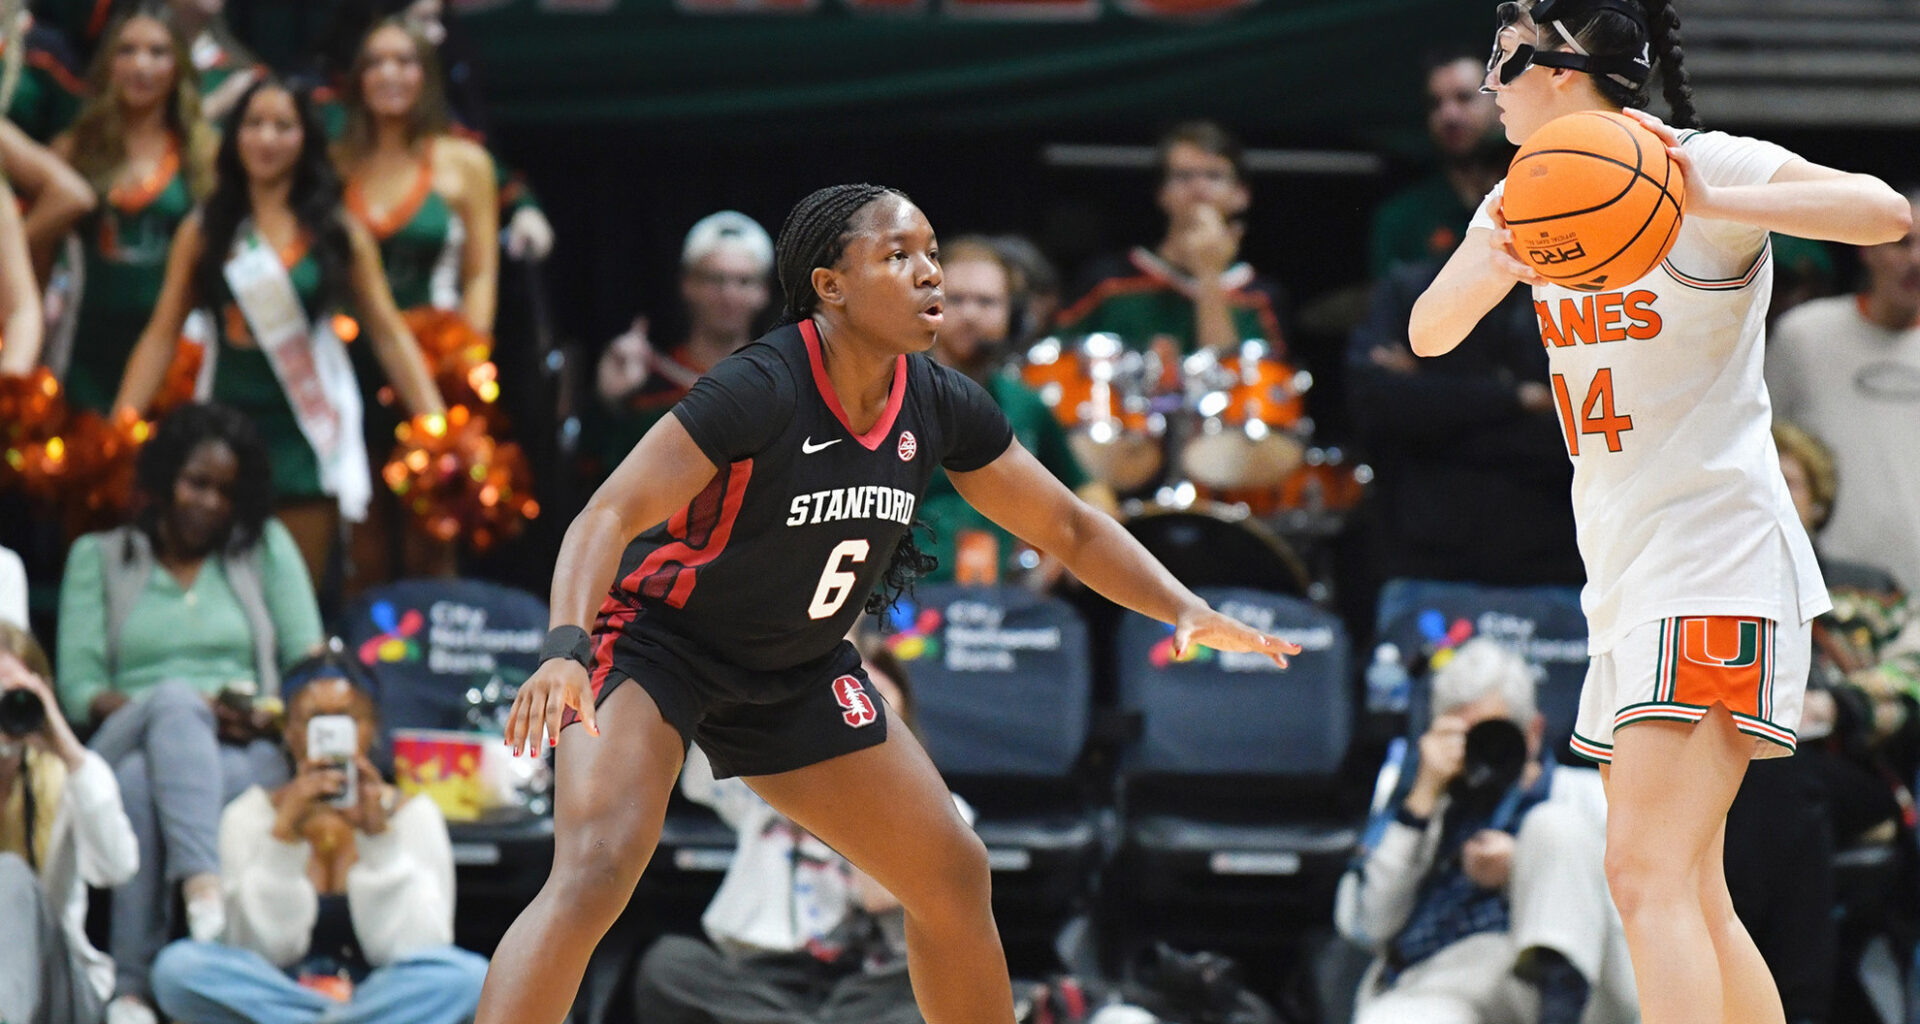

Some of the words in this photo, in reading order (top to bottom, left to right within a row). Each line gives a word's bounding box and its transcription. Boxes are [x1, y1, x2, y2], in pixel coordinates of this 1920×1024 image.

[1529, 242, 1586, 265] PRO
[1534, 290, 1662, 348] ANES
[1552, 367, 1634, 456] 14
[786, 486, 915, 527] STANFORD
[808, 539, 870, 620] 6
[1684, 618, 1758, 667] U
